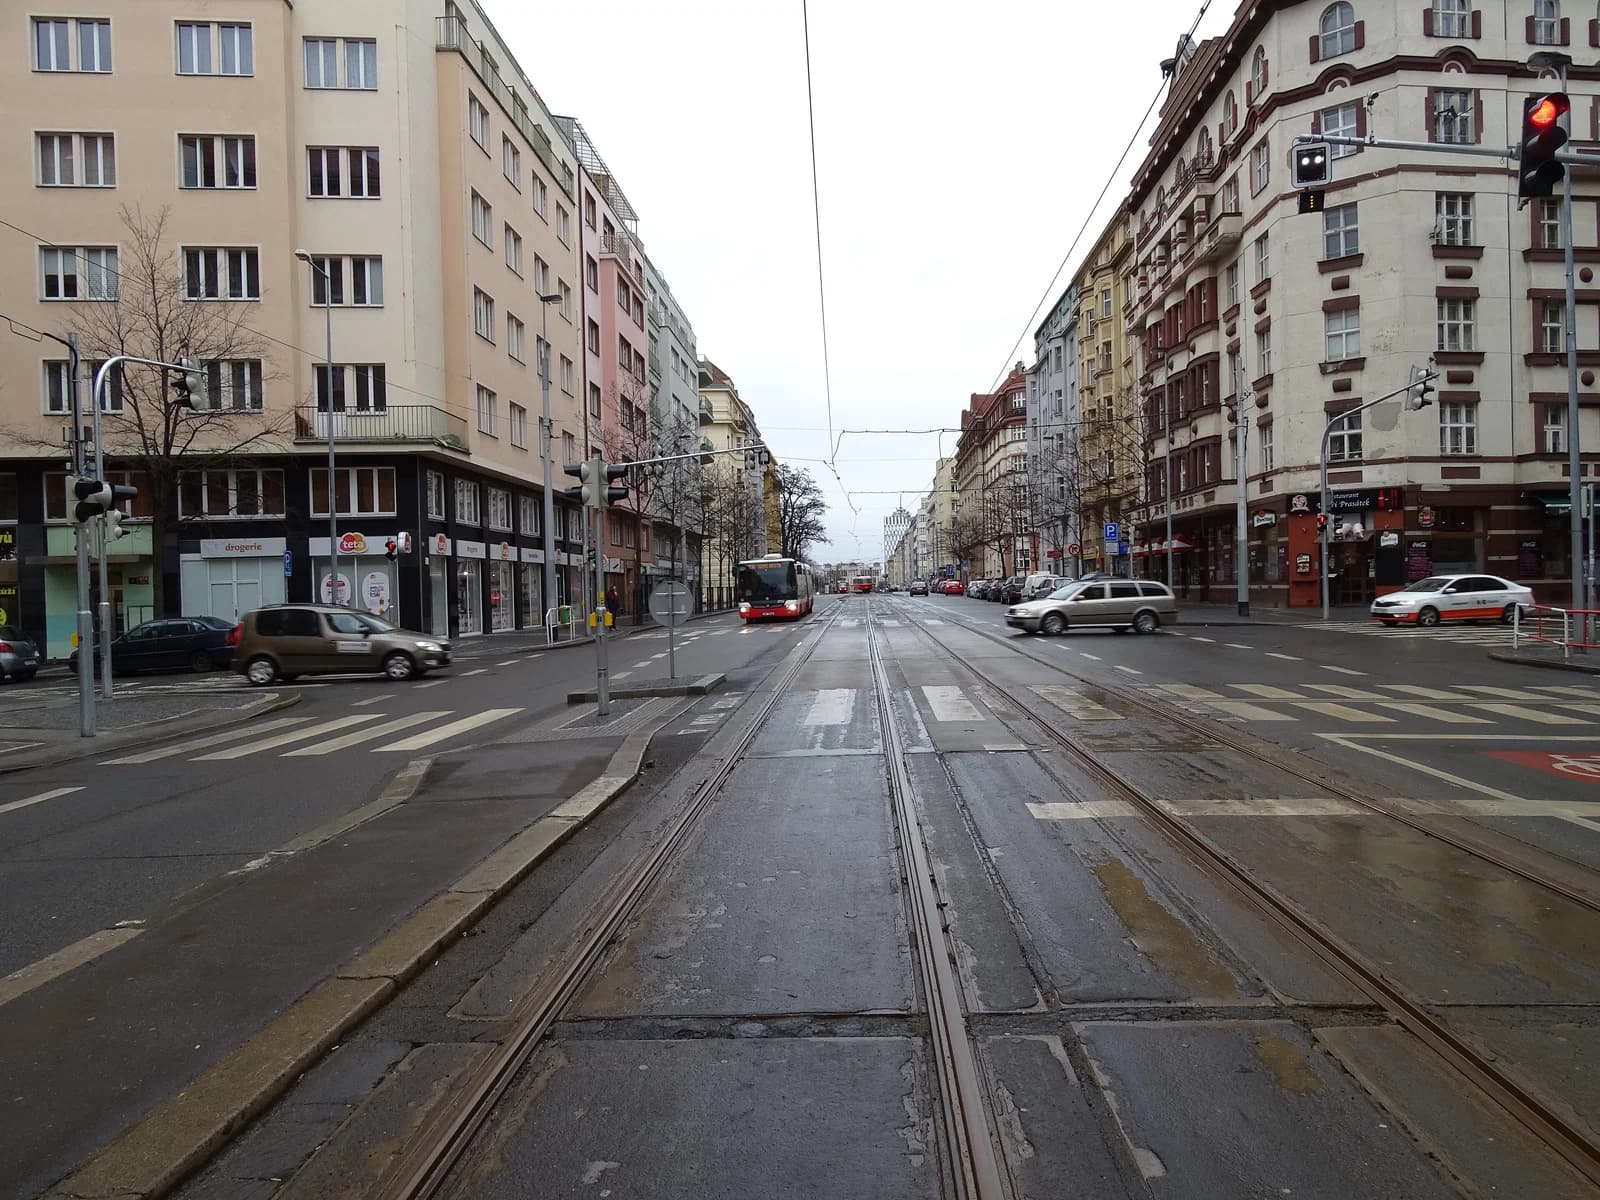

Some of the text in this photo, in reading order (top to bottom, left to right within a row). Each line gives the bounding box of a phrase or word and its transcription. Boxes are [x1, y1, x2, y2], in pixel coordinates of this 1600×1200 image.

[1107, 525, 1115, 537] P
[225, 542, 262, 553] drogerie
[343, 540, 364, 549] teta
